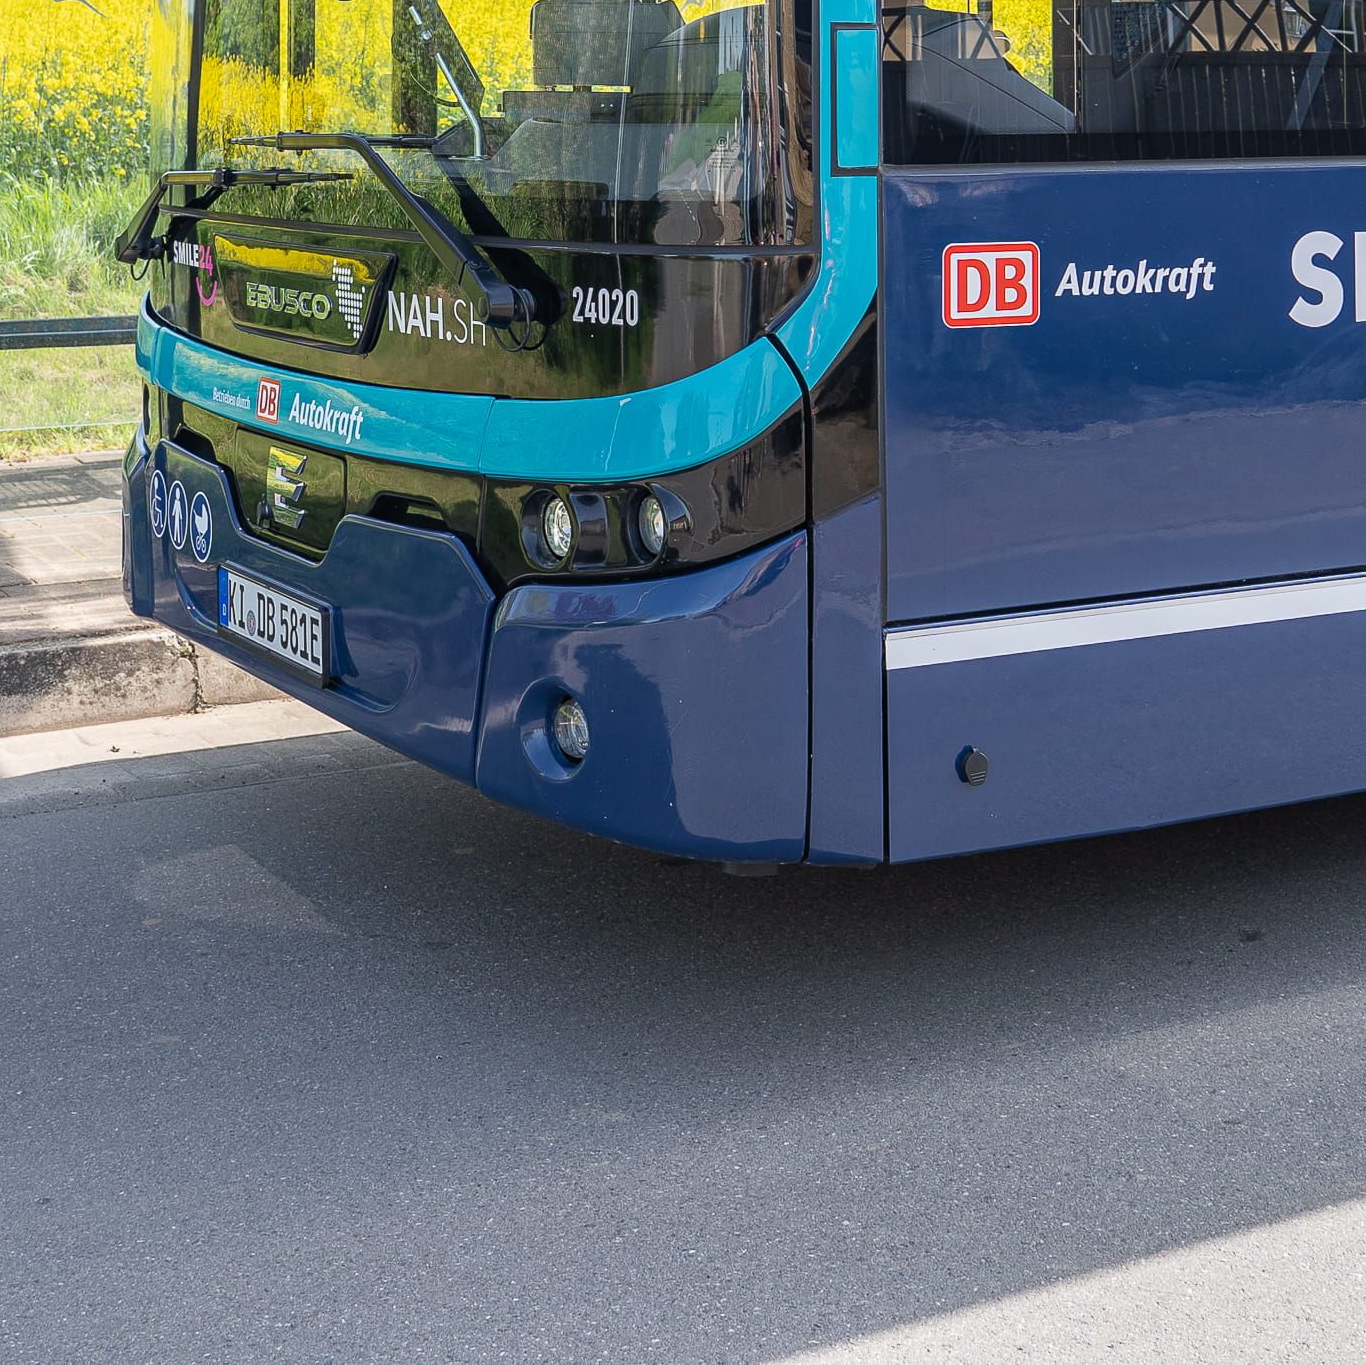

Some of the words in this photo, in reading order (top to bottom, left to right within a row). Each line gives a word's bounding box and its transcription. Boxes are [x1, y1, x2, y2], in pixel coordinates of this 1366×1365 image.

[172, 240, 214, 277] SMILE24
[246, 281, 333, 320] EBUSCO
[571, 285, 640, 327] 24020
[954, 255, 1030, 315] DB
[1053, 256, 1217, 300] Autokraft
[212, 386, 236, 406] Betrieben
[257, 382, 279, 418] DB
[288, 392, 364, 445] Autokraft
[229, 579, 245, 630] KI
[257, 591, 276, 643] DB
[280, 601, 321, 666] 581E
